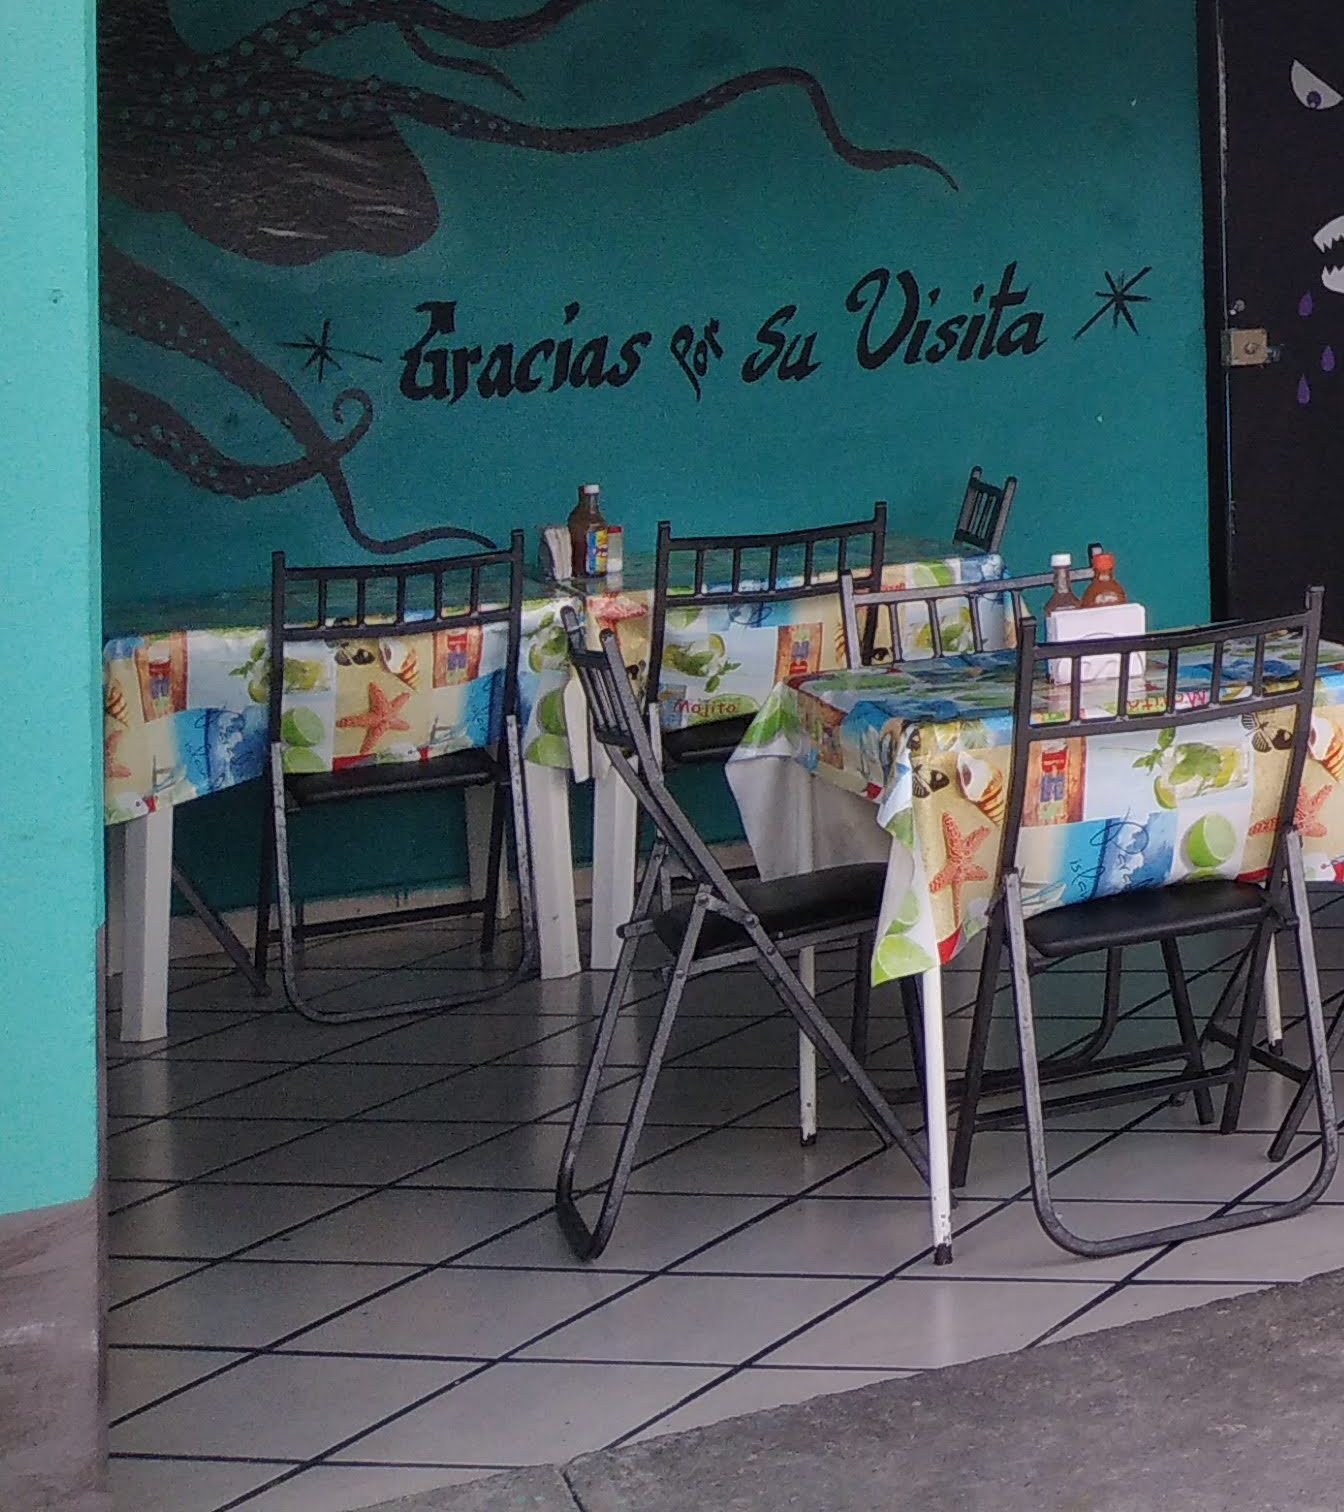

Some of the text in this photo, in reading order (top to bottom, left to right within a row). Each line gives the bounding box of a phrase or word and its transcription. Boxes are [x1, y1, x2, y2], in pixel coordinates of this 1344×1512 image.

[398, 299, 651, 404] Gracias
[741, 303, 819, 385] Su
[845, 259, 1049, 371] Visita
[672, 697, 738, 718] Mojito
